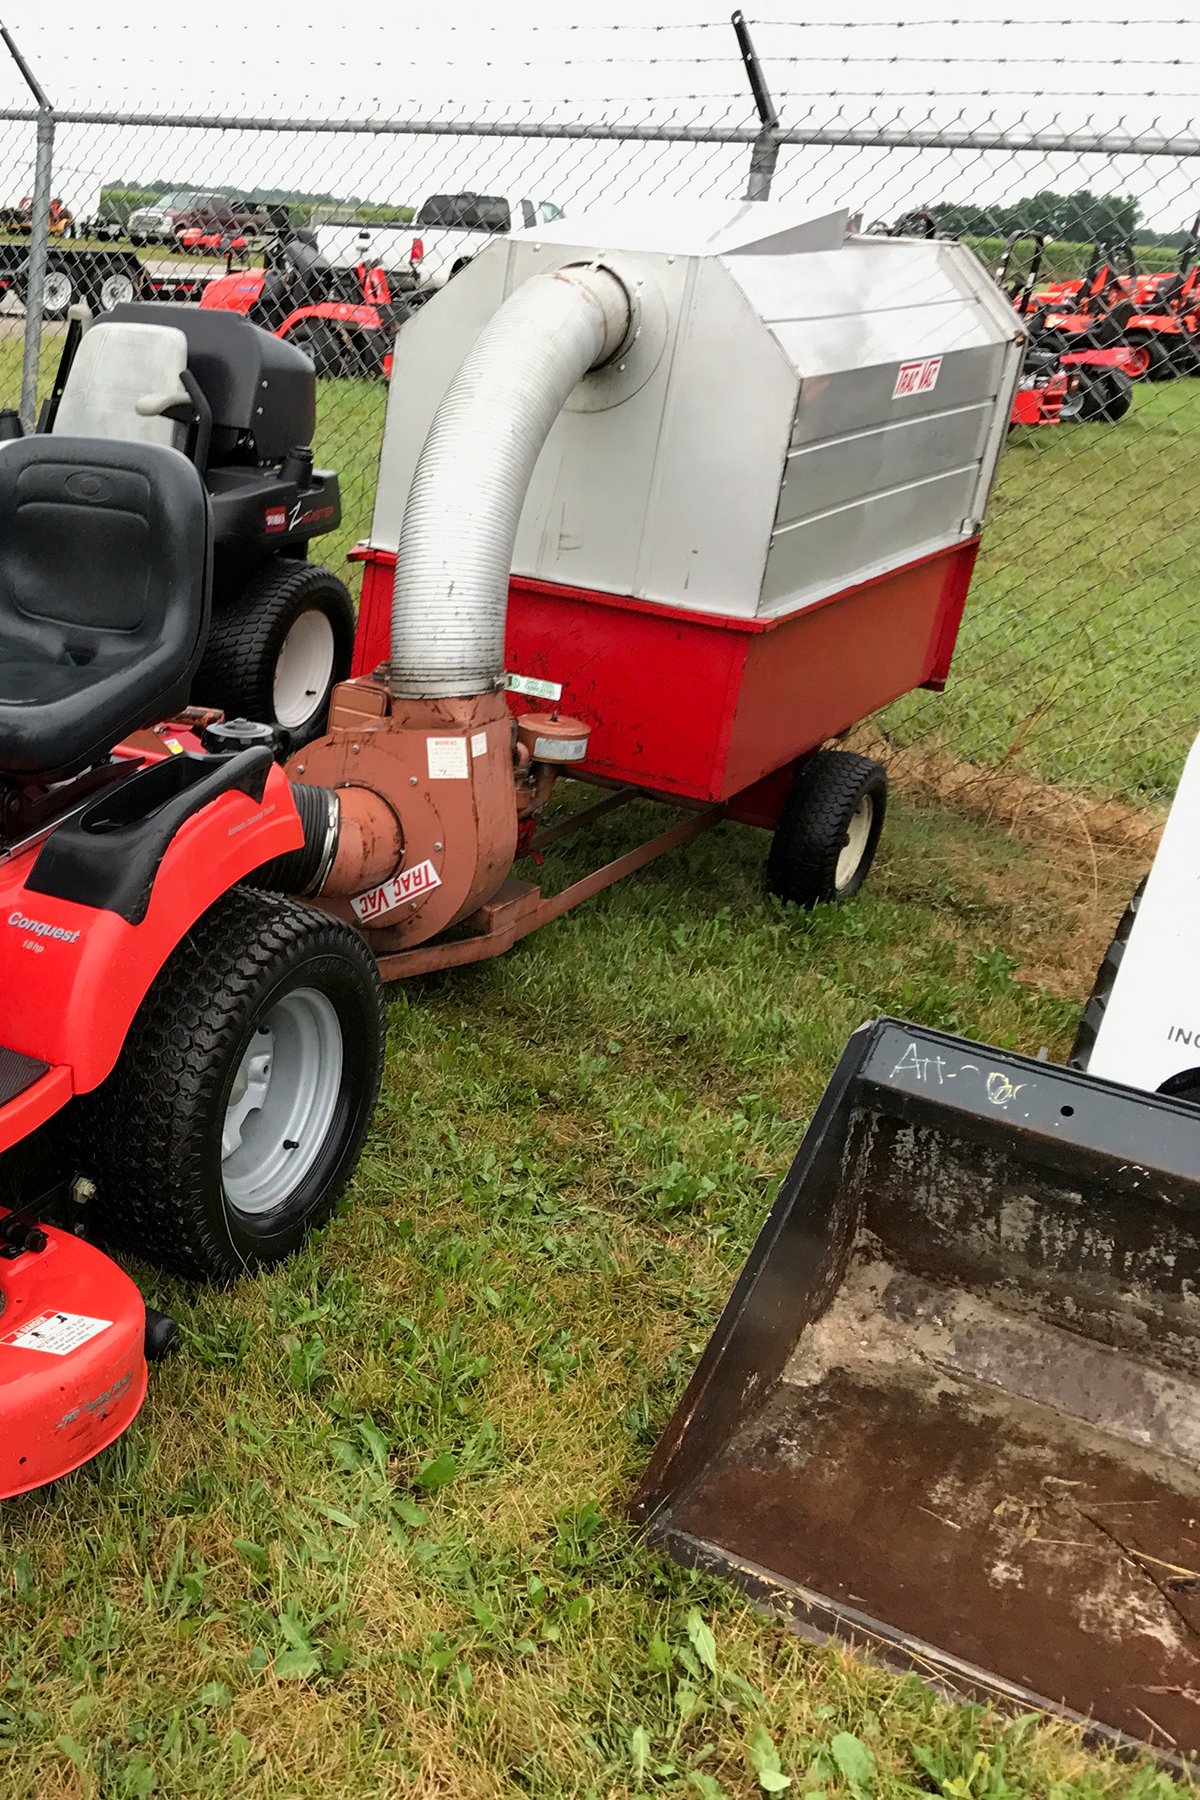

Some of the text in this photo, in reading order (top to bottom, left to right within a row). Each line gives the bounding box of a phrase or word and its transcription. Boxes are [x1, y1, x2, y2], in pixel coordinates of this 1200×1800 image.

[895, 359, 940, 395] TRAC VAC
[359, 864, 437, 920] TRAC VAC
[7, 911, 82, 944] Conquest
